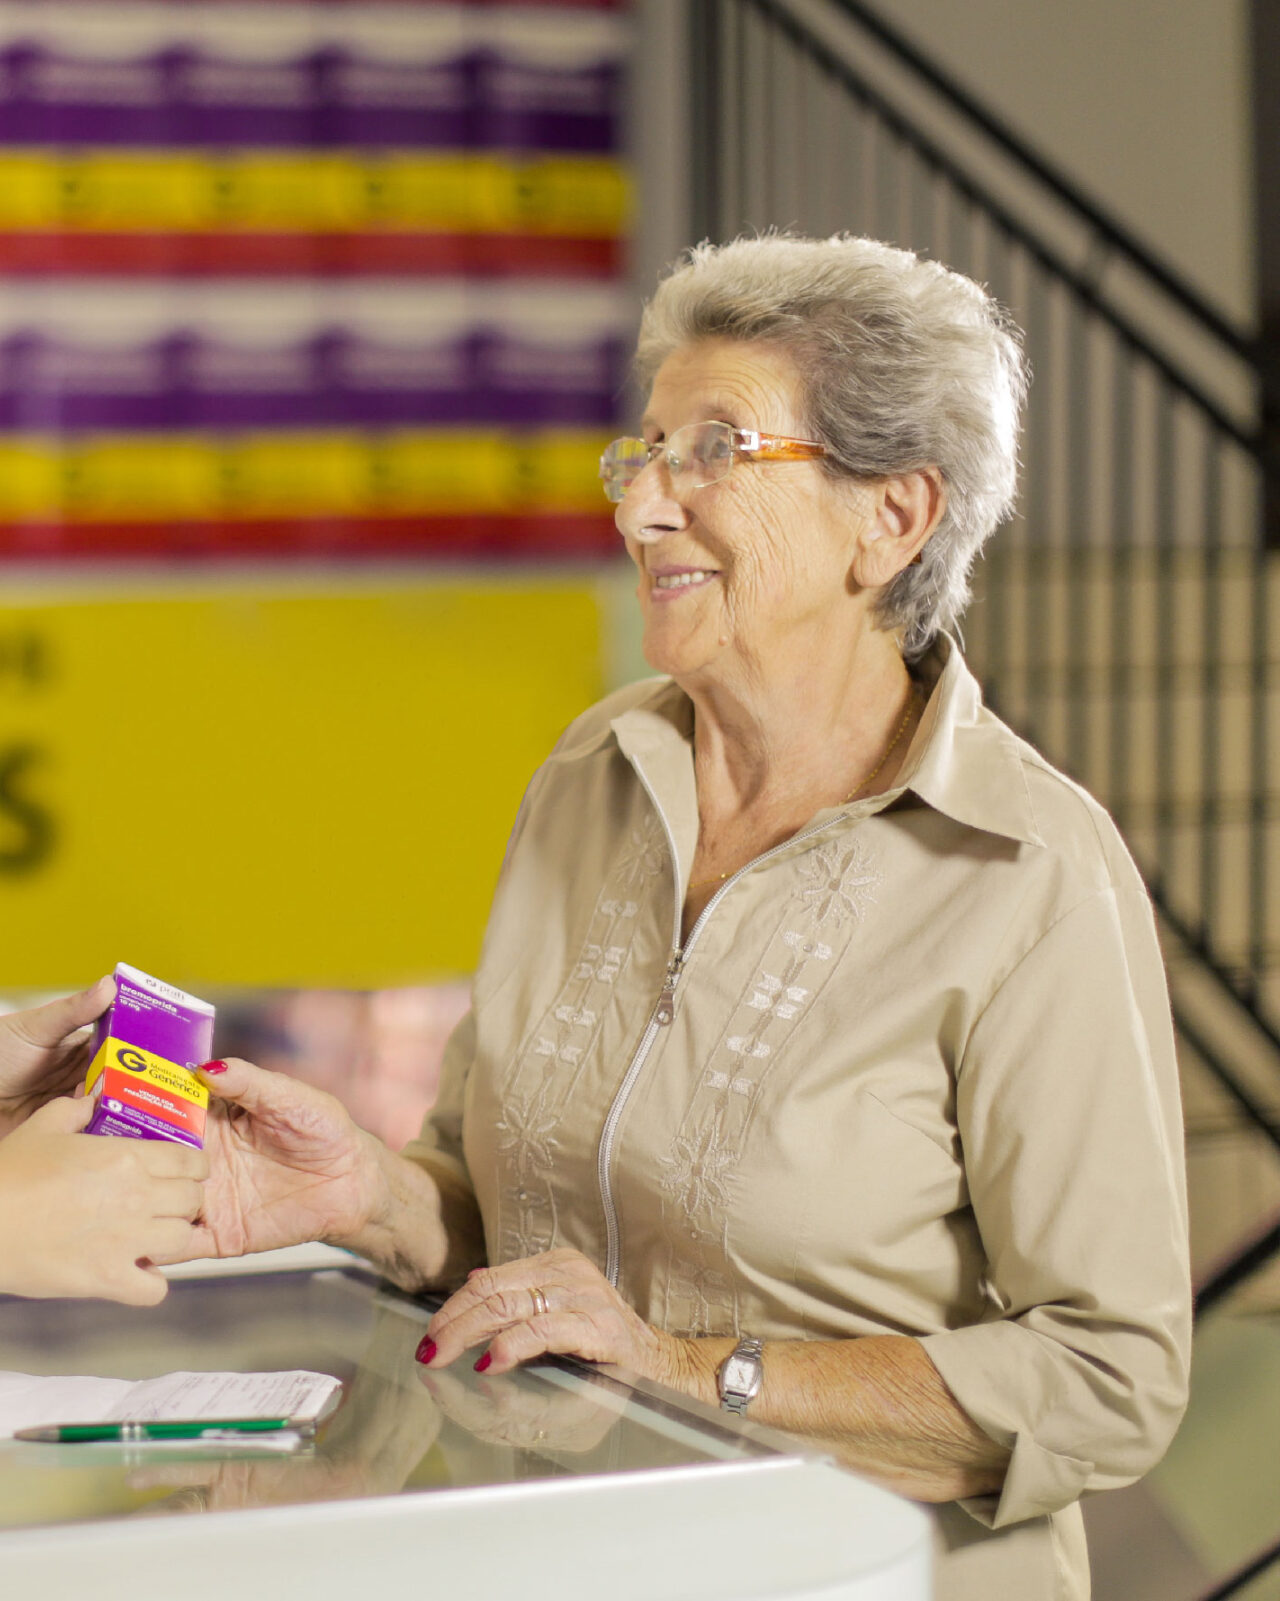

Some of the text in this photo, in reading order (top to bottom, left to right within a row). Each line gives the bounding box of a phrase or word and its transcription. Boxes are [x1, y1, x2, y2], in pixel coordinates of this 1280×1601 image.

[120, 983, 178, 1013] bromoprida
[116, 1048, 148, 1073] G
[148, 1068, 200, 1099] Genérico
